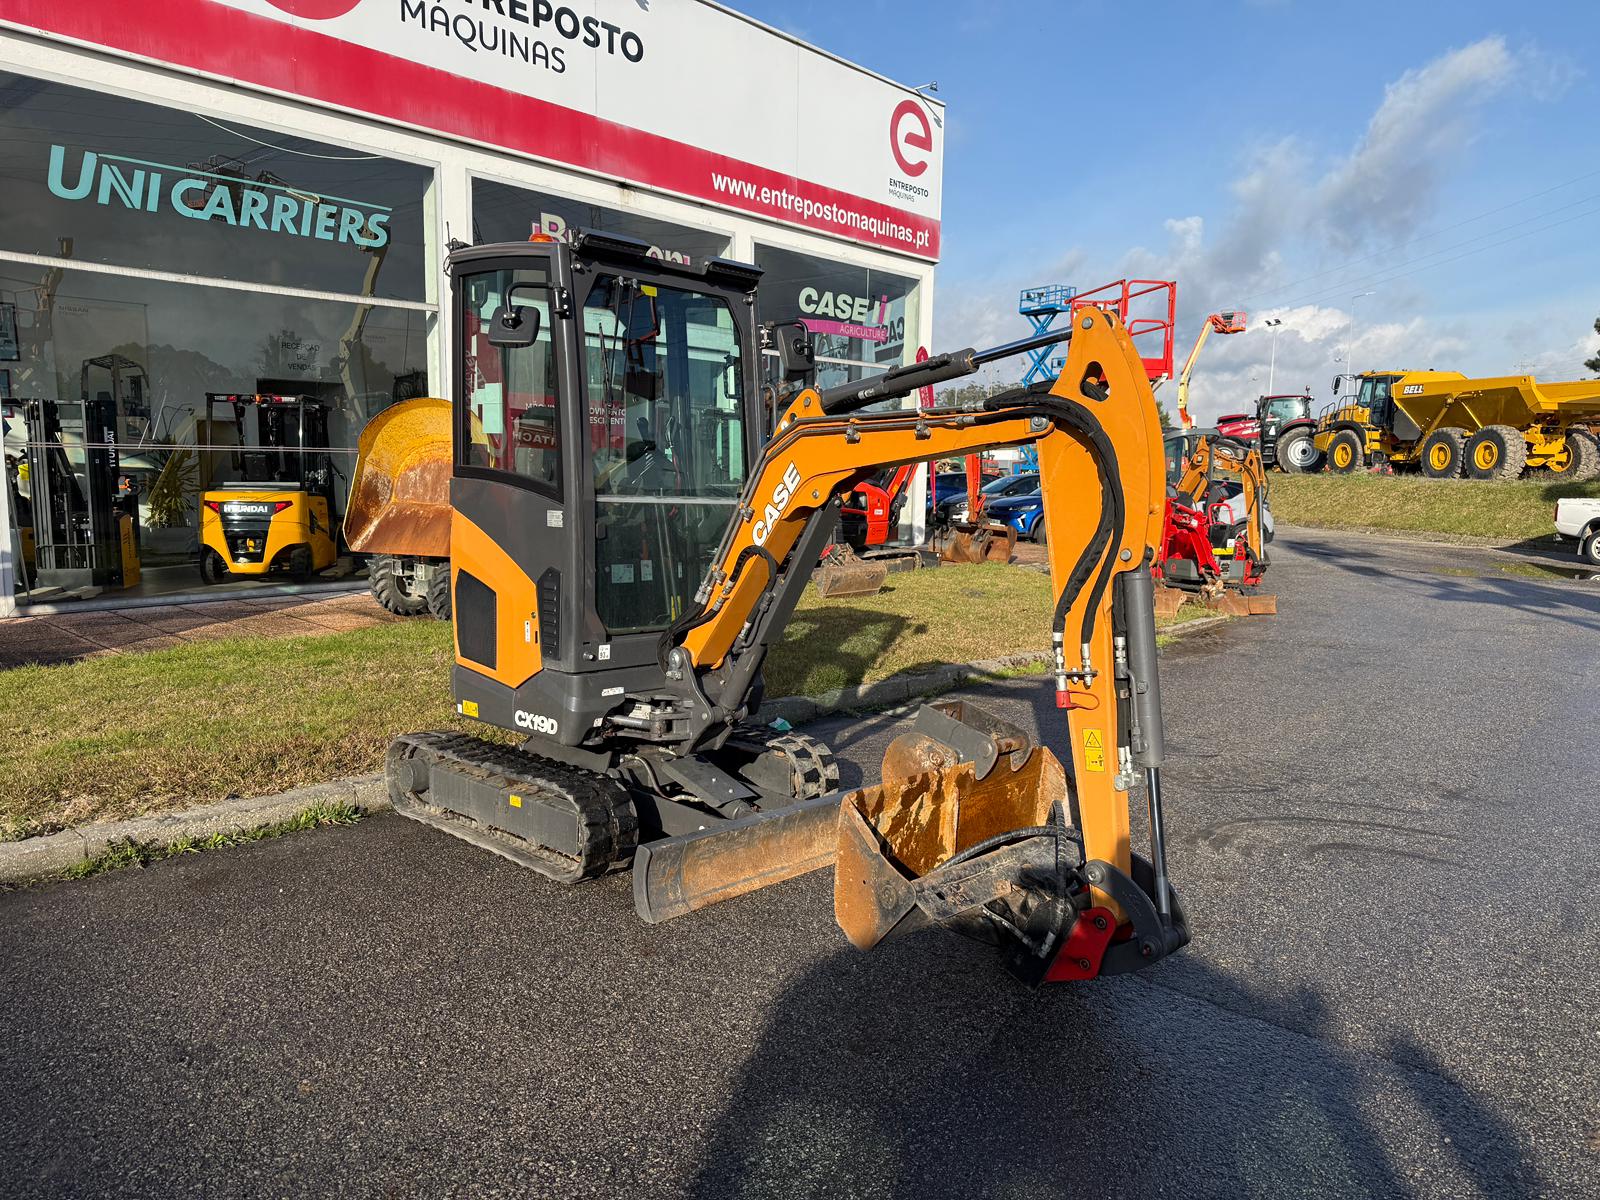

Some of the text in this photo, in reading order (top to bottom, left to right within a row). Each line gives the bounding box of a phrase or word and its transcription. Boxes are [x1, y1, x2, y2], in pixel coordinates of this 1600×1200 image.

[889, 178, 929, 198] ENTREPOSTO
[711, 172, 930, 249] www.entrepostomaquinas.pt
[798, 286, 870, 322] CASE
[839, 324, 886, 341] AGRICULTURE
[1403, 385, 1424, 395] BELL
[223, 504, 268, 513] HYUNDAI
[751, 460, 801, 548] CASE
[514, 709, 558, 735] CX19D
